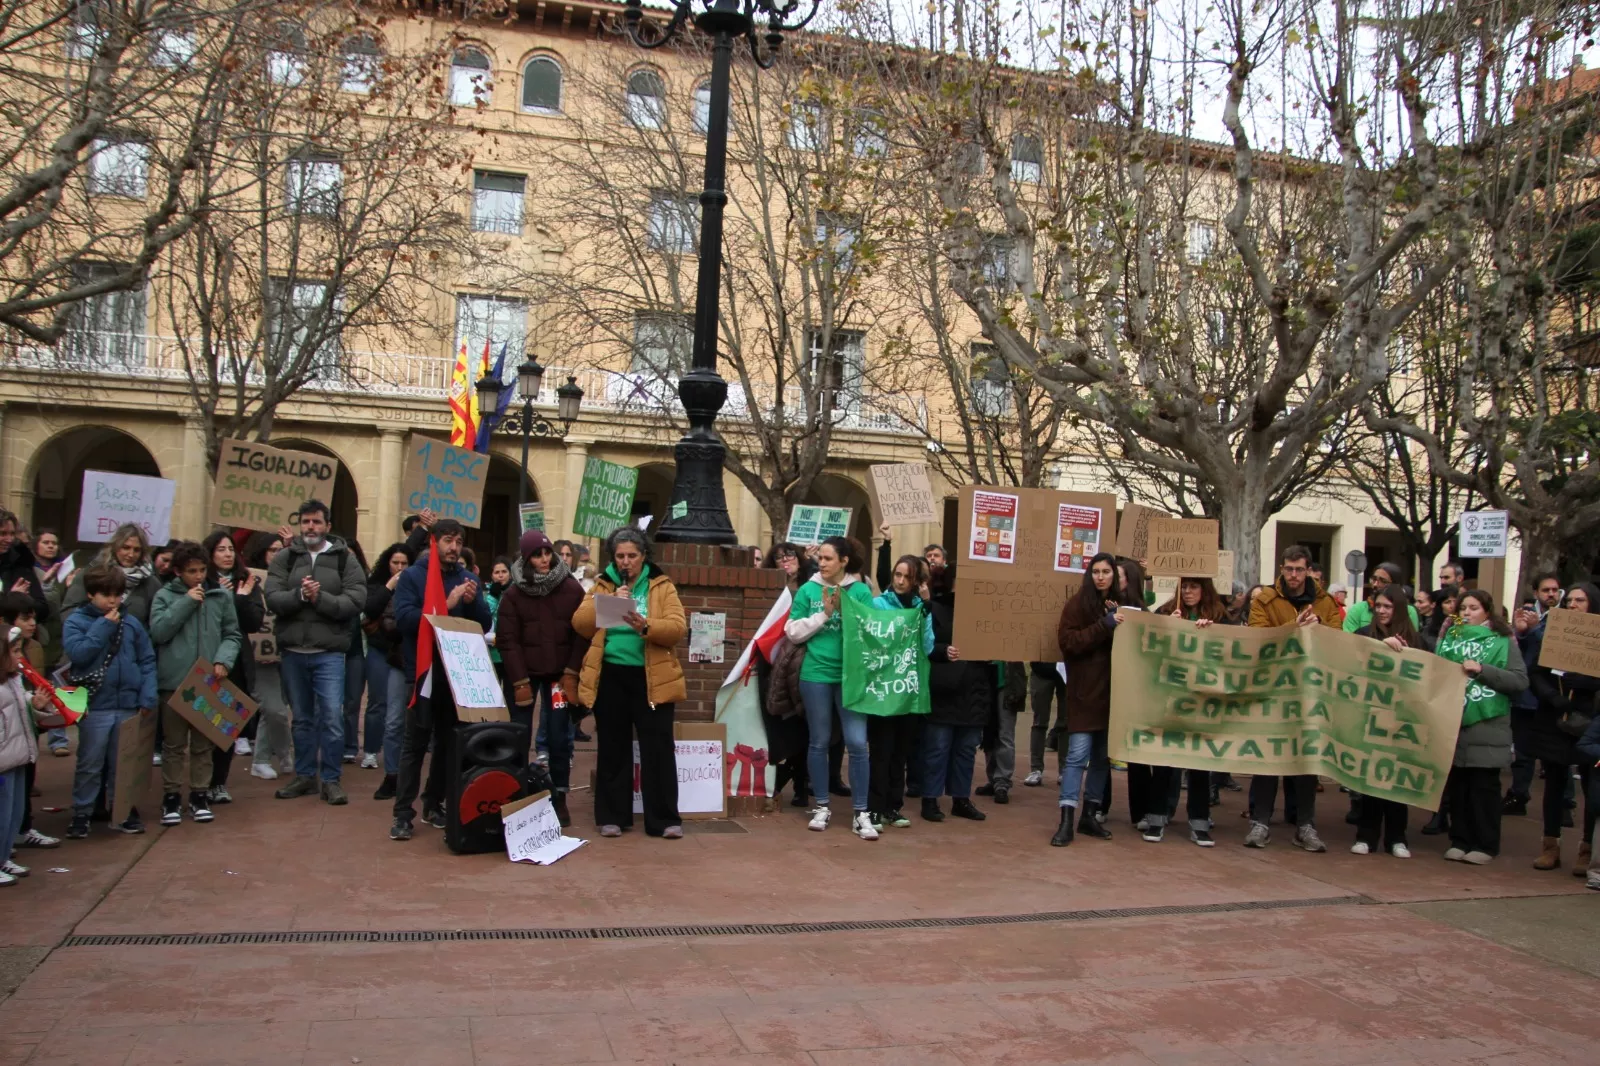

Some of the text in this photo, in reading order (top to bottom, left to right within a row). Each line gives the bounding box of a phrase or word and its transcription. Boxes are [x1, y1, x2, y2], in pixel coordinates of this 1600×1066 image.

[227, 446, 332, 481] IGUALDAD
[417, 441, 484, 481] 1 PSC
[426, 474, 456, 497] POR
[886, 475, 919, 491] REAL
[409, 491, 477, 522] CENTRO
[590, 483, 631, 517] ESCUELAS
[880, 492, 895, 502] NO
[219, 499, 284, 525] ENTRE
[800, 509, 813, 520] NO!
[828, 511, 842, 522] NO!
[1153, 556, 1207, 570] CALIDAD
[1010, 599, 1064, 612] CALIDA
[1147, 631, 1424, 681] HUELGA DE
[1167, 664, 1394, 705] EDUCACIÓN
[1174, 697, 1420, 745] CONTRA LA
